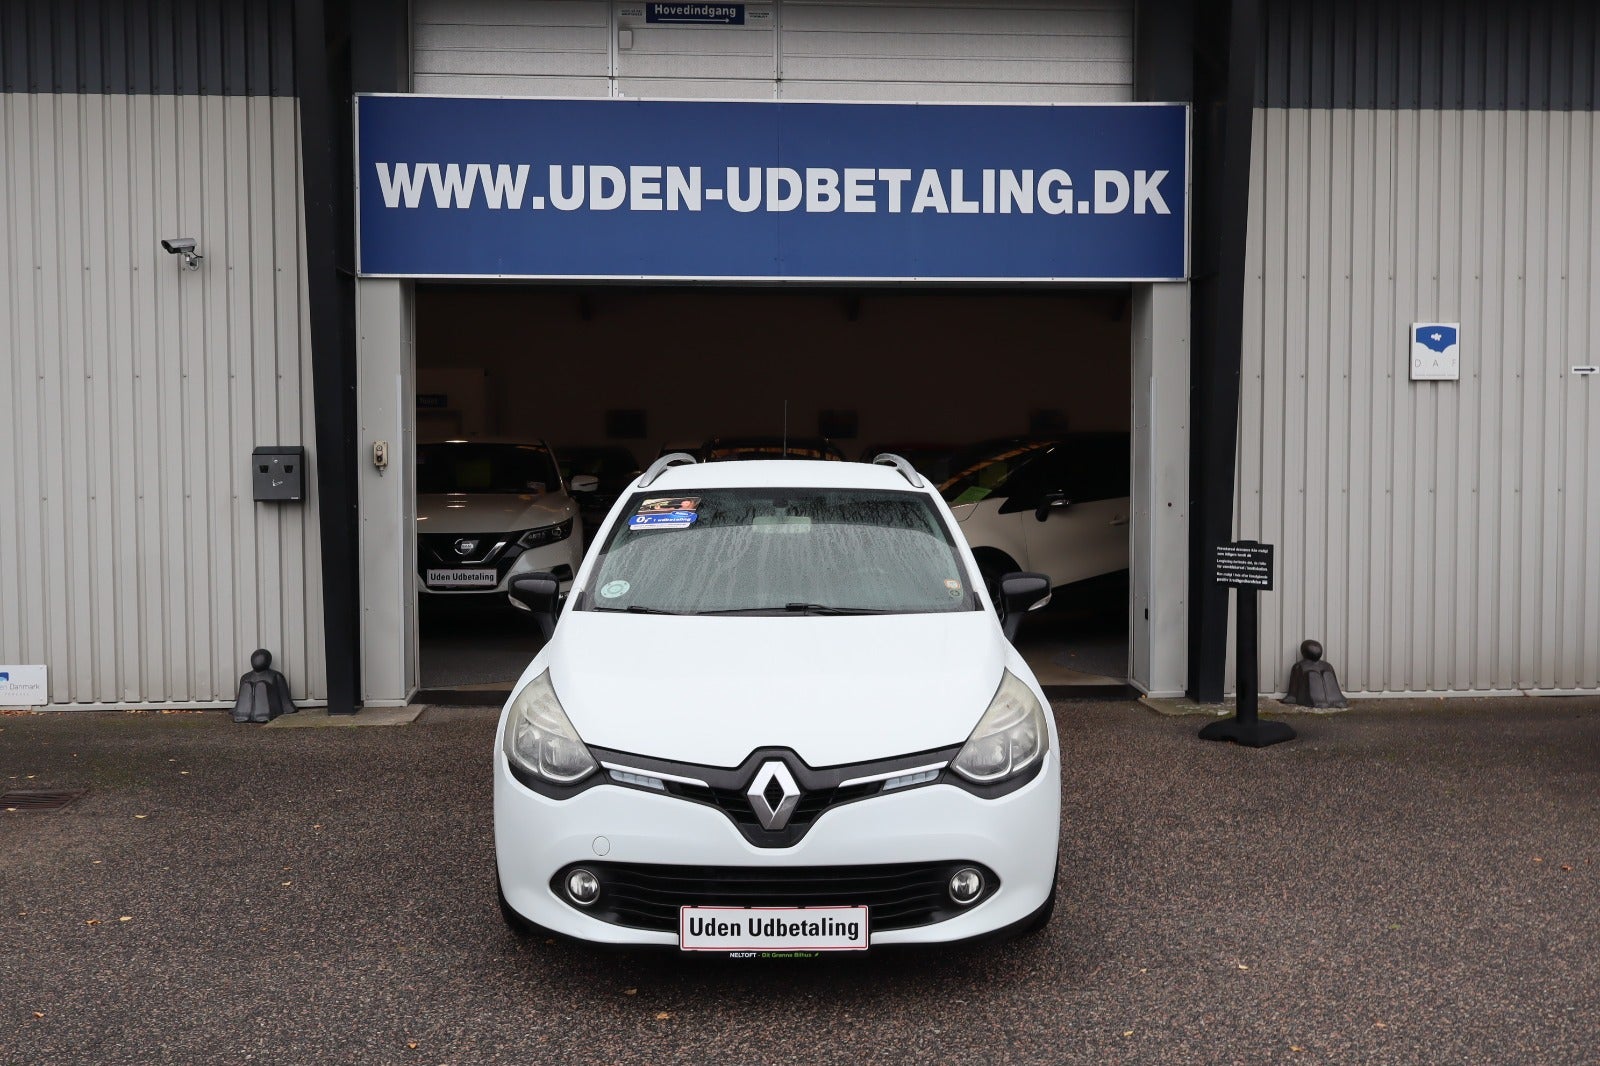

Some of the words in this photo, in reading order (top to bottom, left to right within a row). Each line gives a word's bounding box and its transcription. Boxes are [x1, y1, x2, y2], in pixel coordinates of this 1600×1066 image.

[654, 4, 736, 17] Hovedindgang
[375, 162, 1171, 216] WWW.UDEN-UDBETALING.DK
[430, 572, 450, 581] Uden
[452, 572, 494, 582] Udbetaling
[690, 918, 741, 936] Uden
[749, 918, 859, 940] Udbetaling
